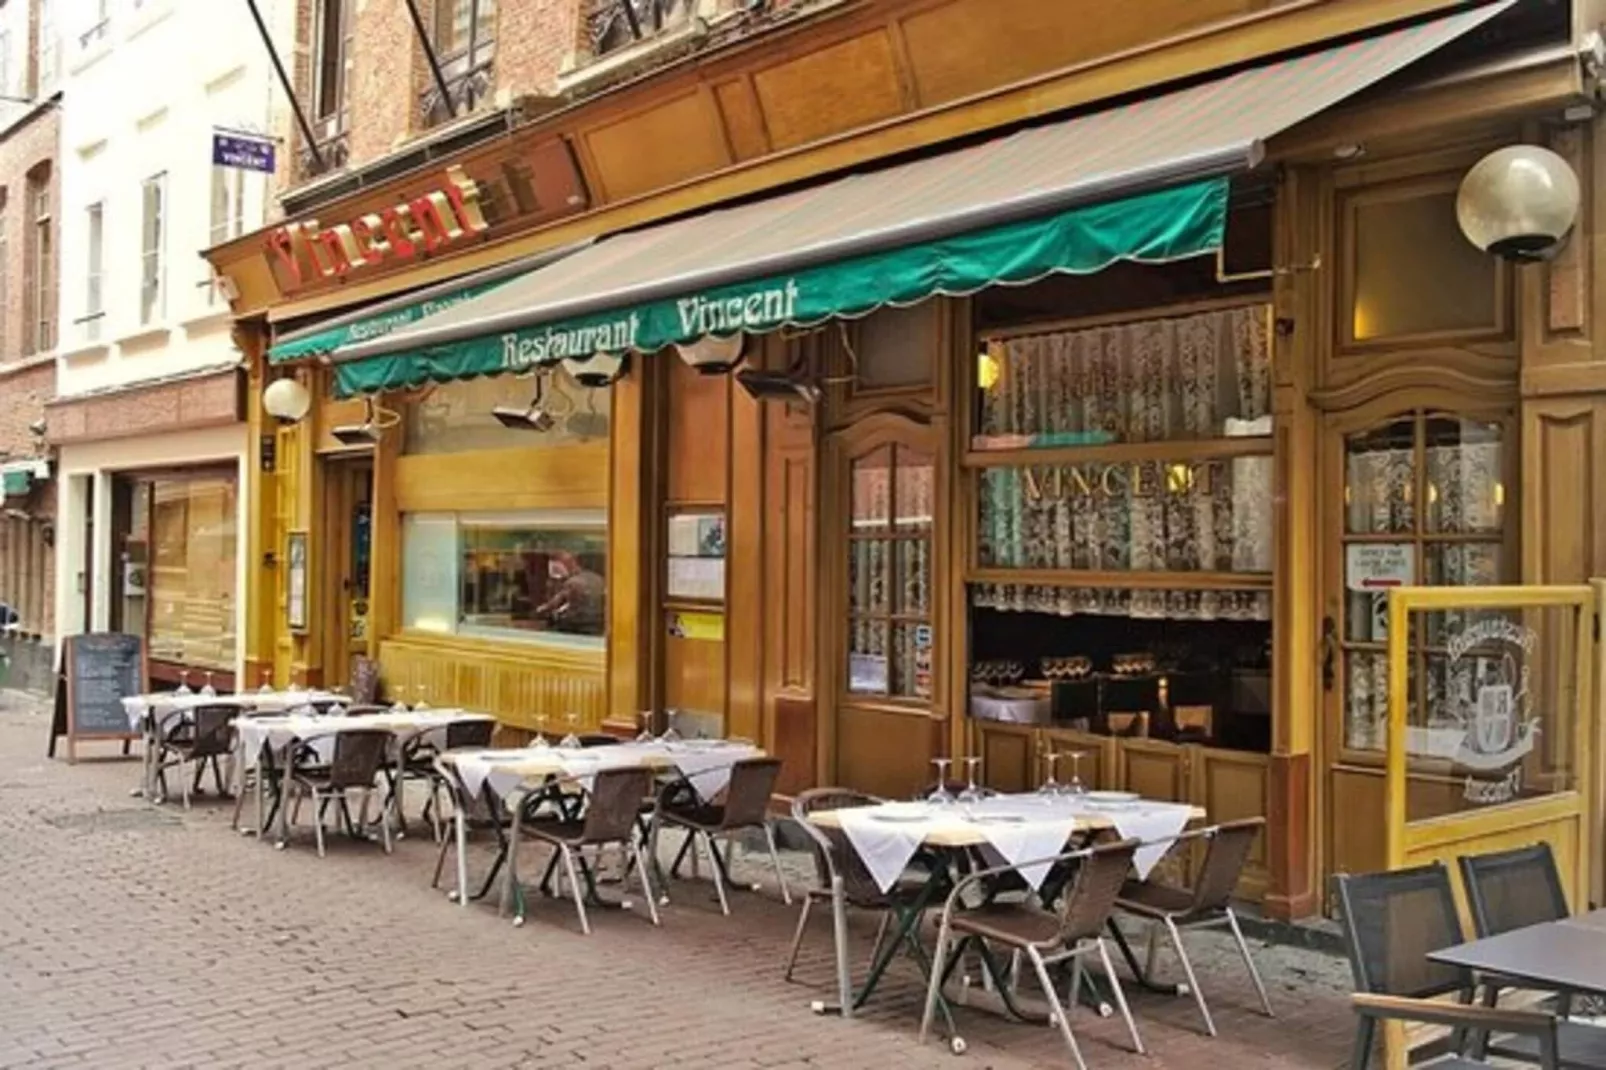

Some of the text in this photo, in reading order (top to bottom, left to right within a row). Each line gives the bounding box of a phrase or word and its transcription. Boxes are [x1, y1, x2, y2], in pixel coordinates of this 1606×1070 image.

[265, 164, 489, 282] Vincent
[500, 278, 799, 368] Restaurant Vincent
[1023, 459, 1226, 499] VINCENT
